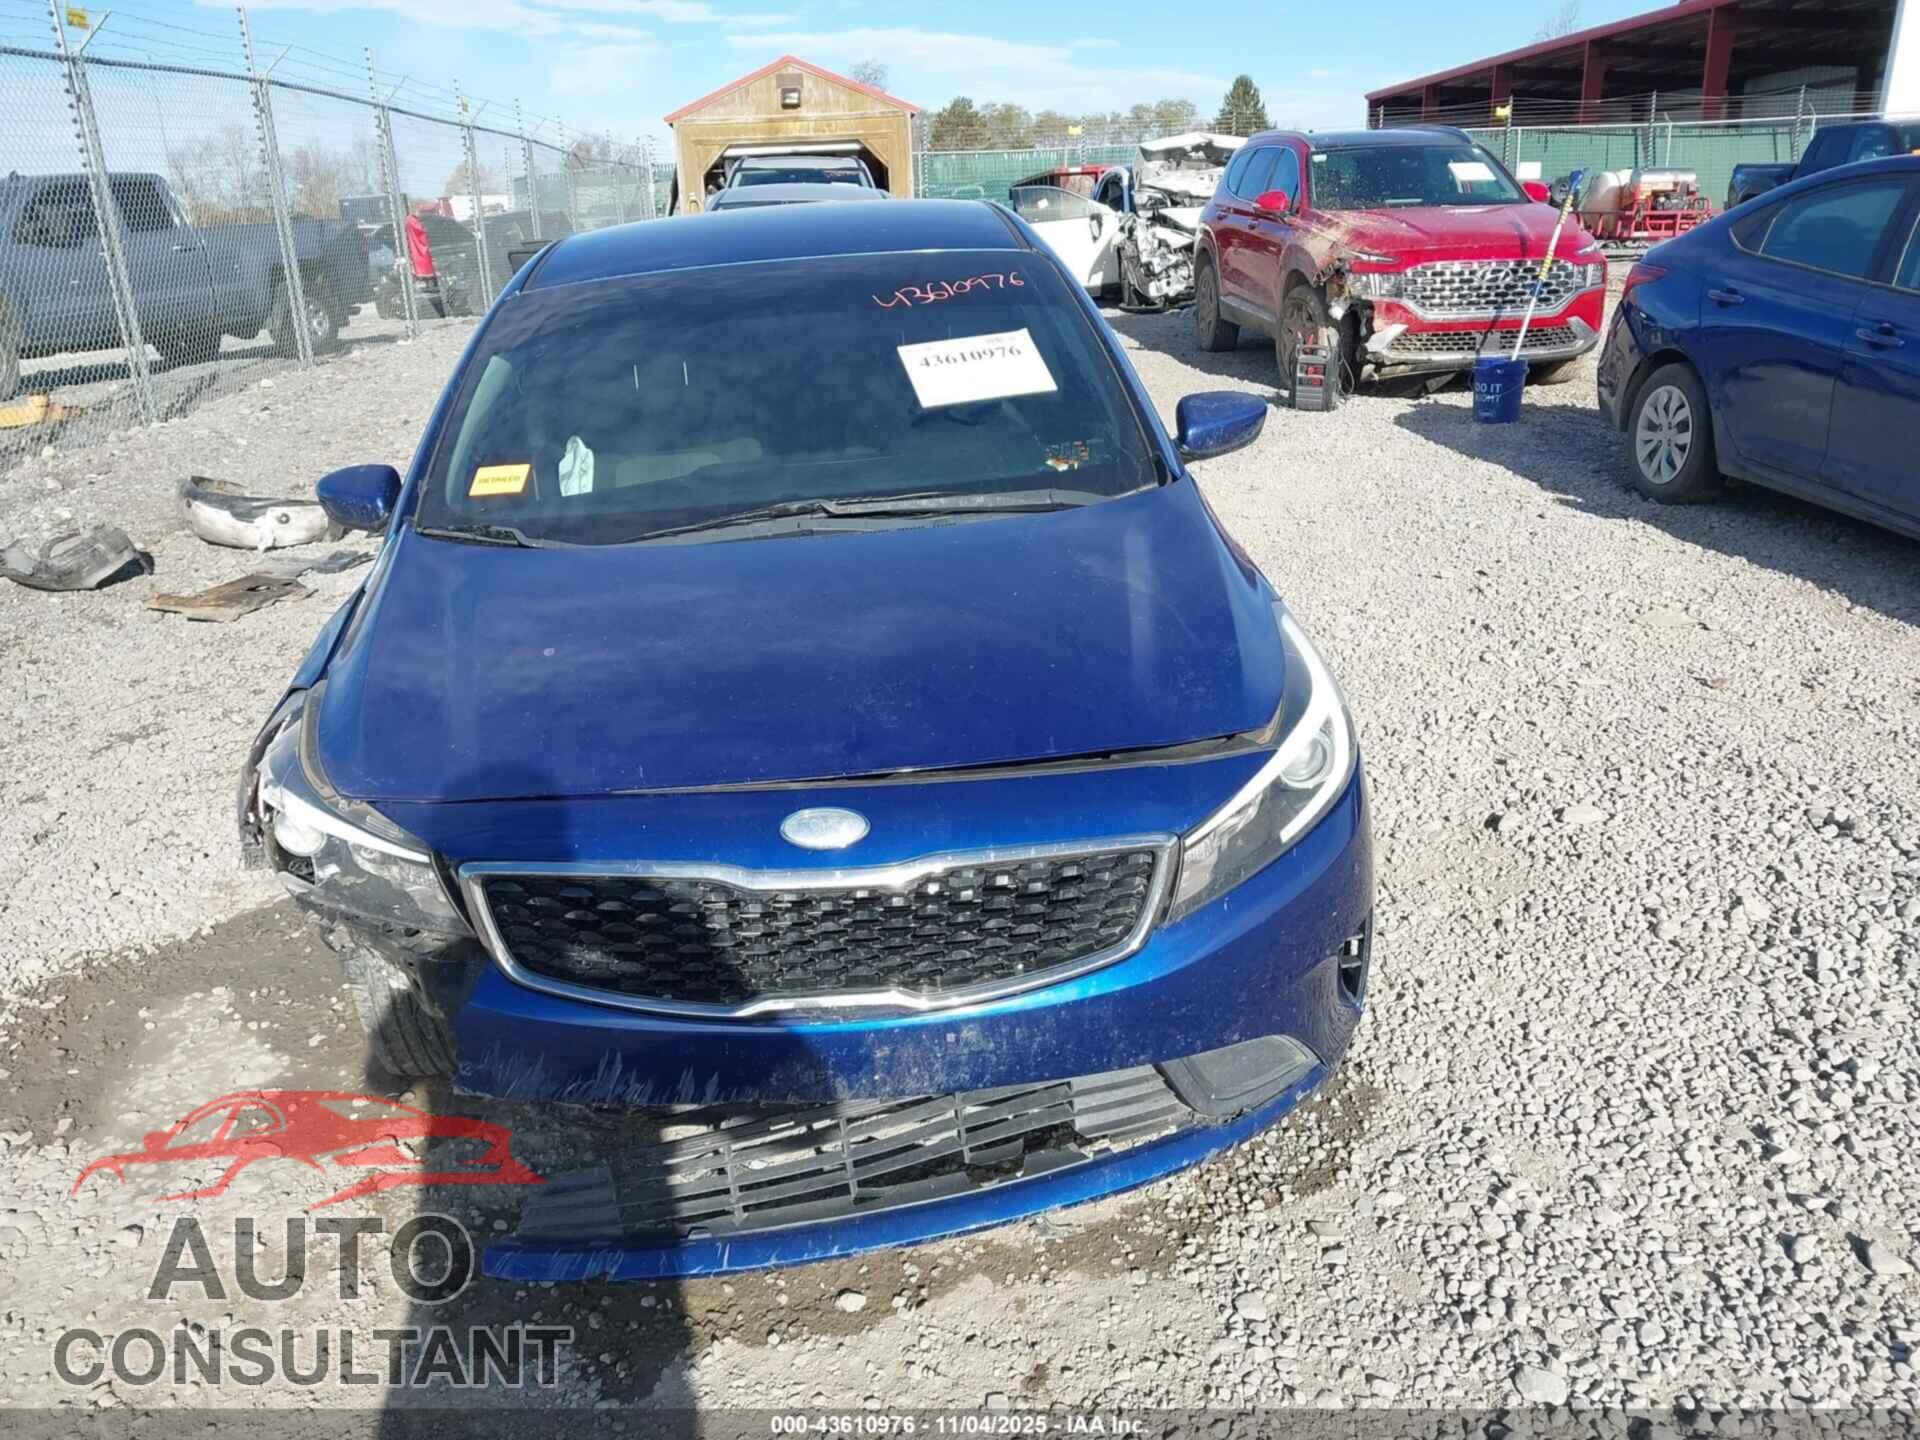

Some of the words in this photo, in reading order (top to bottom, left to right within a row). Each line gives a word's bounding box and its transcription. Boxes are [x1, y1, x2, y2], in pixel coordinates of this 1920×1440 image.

[871, 272, 1025, 308] 43610976
[918, 344, 1022, 369] 43610976
[1490, 383, 1502, 393] IT
